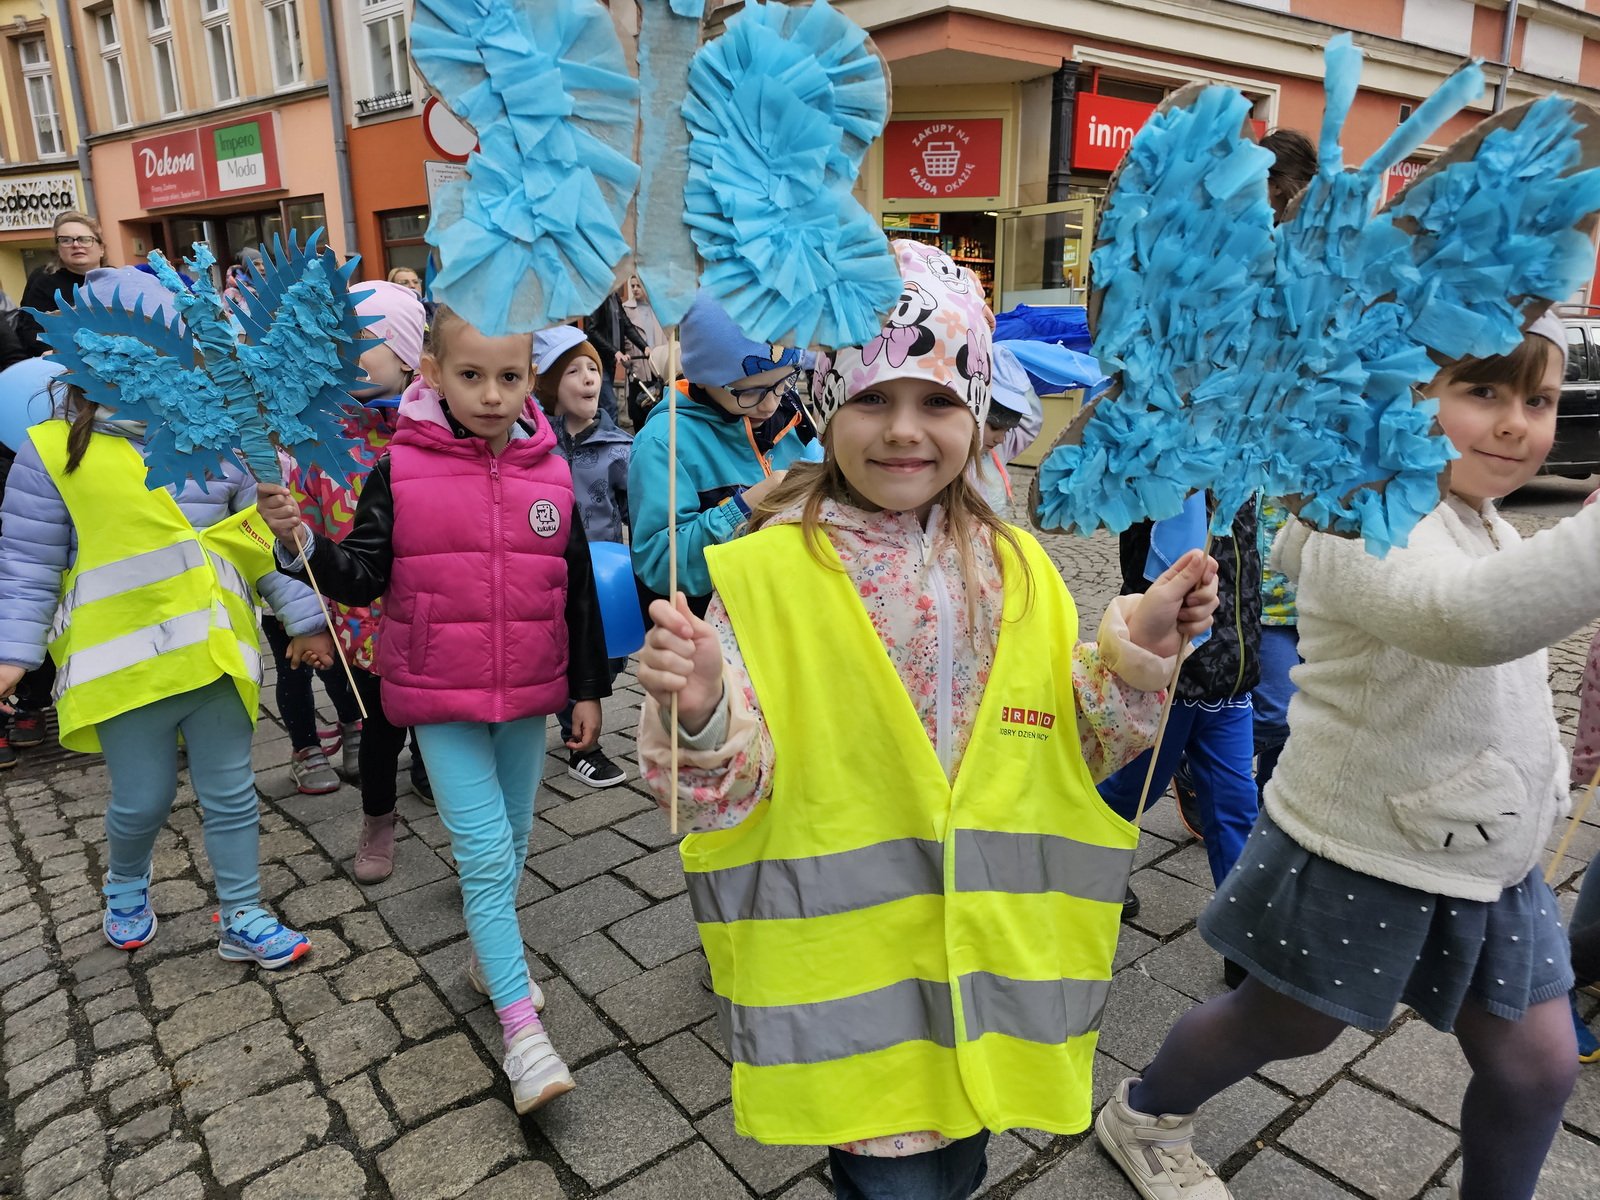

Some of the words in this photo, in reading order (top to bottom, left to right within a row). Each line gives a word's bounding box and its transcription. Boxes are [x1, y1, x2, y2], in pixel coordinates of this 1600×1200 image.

[218, 133, 255, 157] Impero
[911, 124, 955, 147] ZAKUPY
[956, 129, 970, 145] NA
[138, 146, 195, 178] Dekora
[227, 158, 257, 178] Moda
